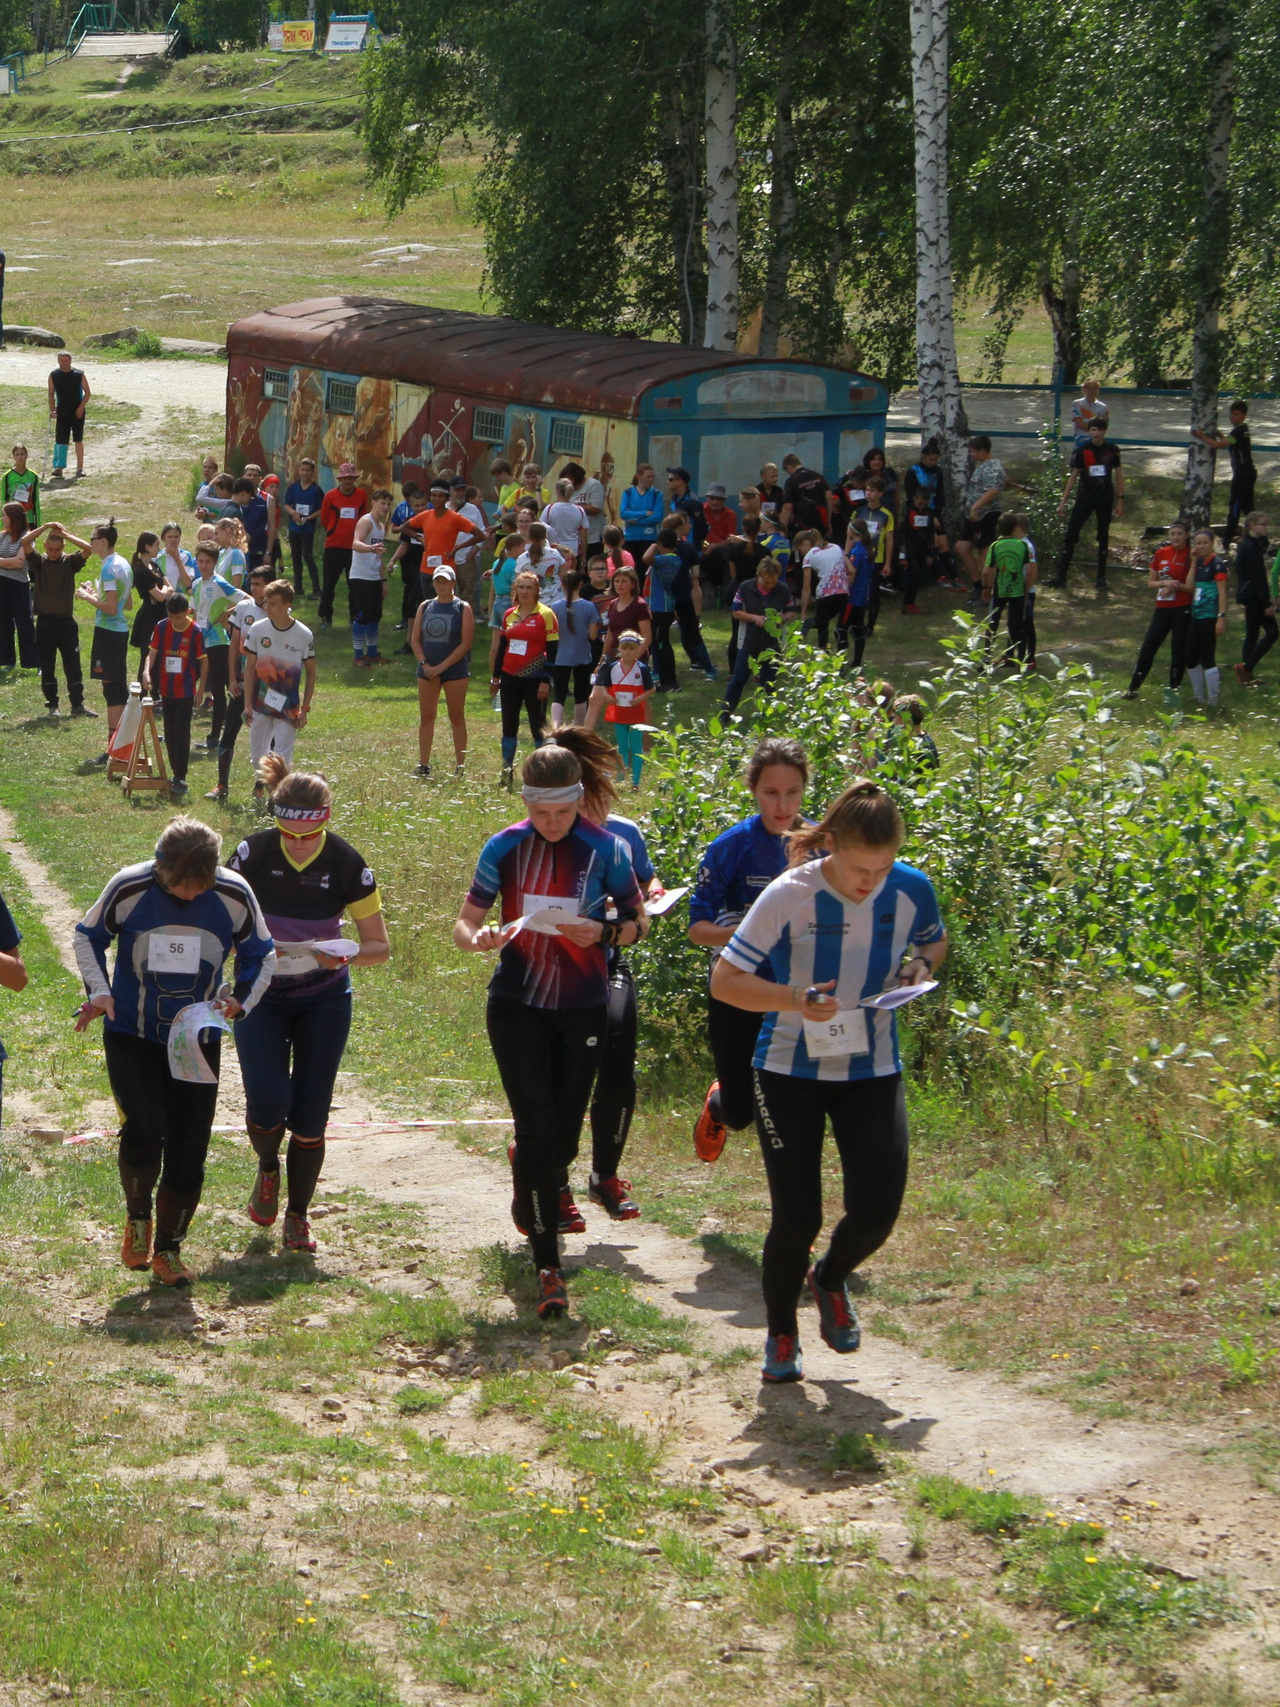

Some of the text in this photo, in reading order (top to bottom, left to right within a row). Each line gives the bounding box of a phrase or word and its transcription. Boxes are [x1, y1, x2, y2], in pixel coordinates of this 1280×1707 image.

[274, 804, 328, 820] RIMTEX
[169, 943, 184, 954] 56
[829, 1023, 845, 1037] 51
[753, 1070, 785, 1149] agheera
